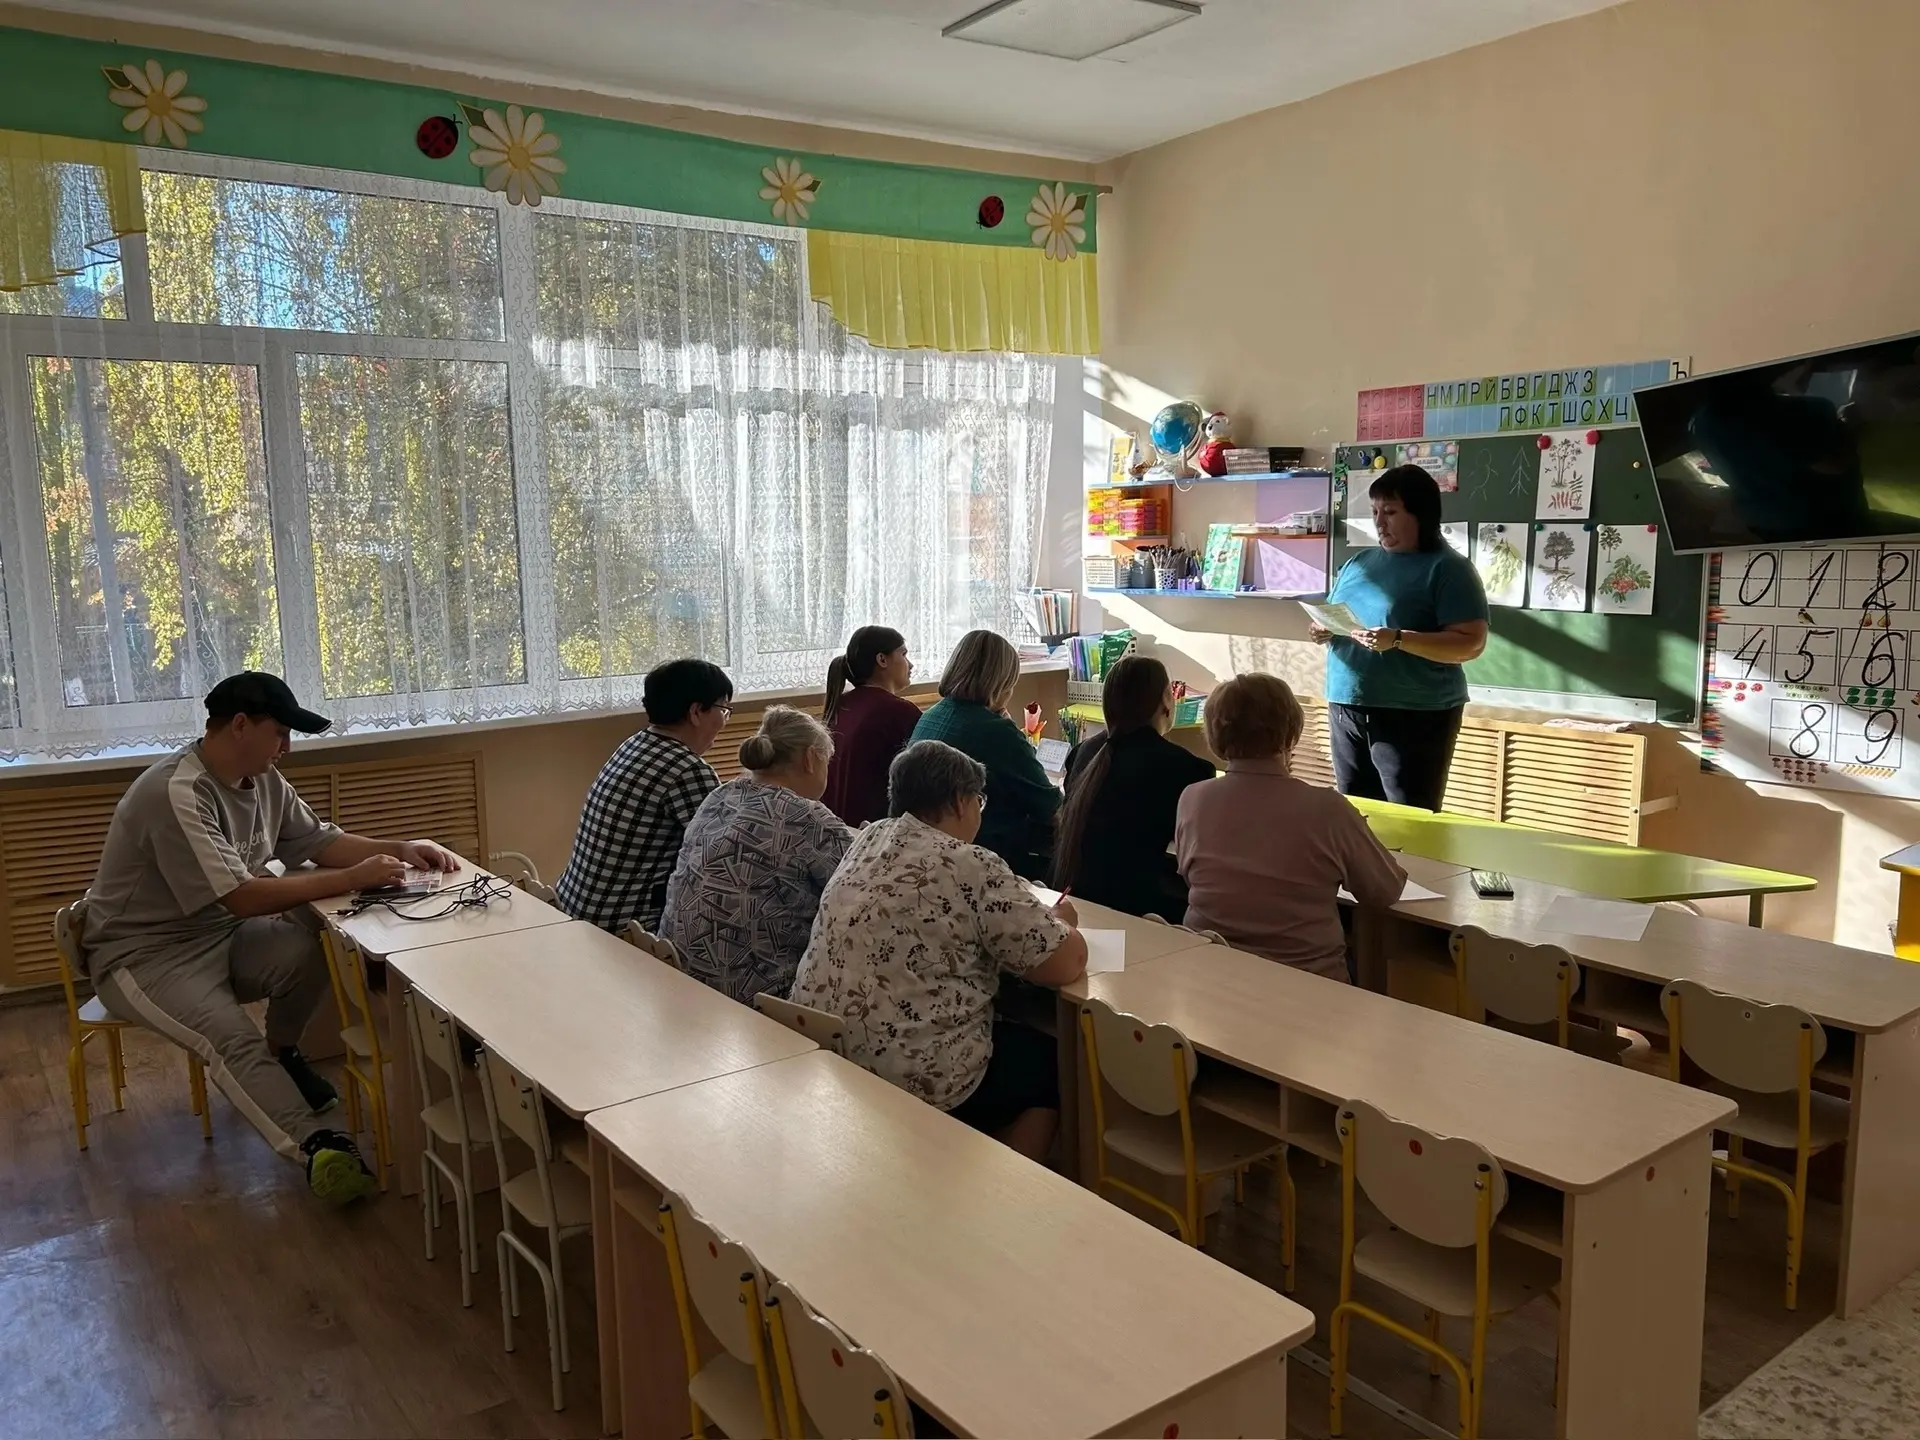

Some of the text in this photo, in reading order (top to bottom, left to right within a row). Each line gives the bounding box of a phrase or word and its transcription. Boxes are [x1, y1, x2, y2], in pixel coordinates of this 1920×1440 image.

[1738, 551, 1909, 610] 0 1 2
[1733, 626, 1906, 687] 4 5 6
[1789, 703, 1898, 765] 8 9
